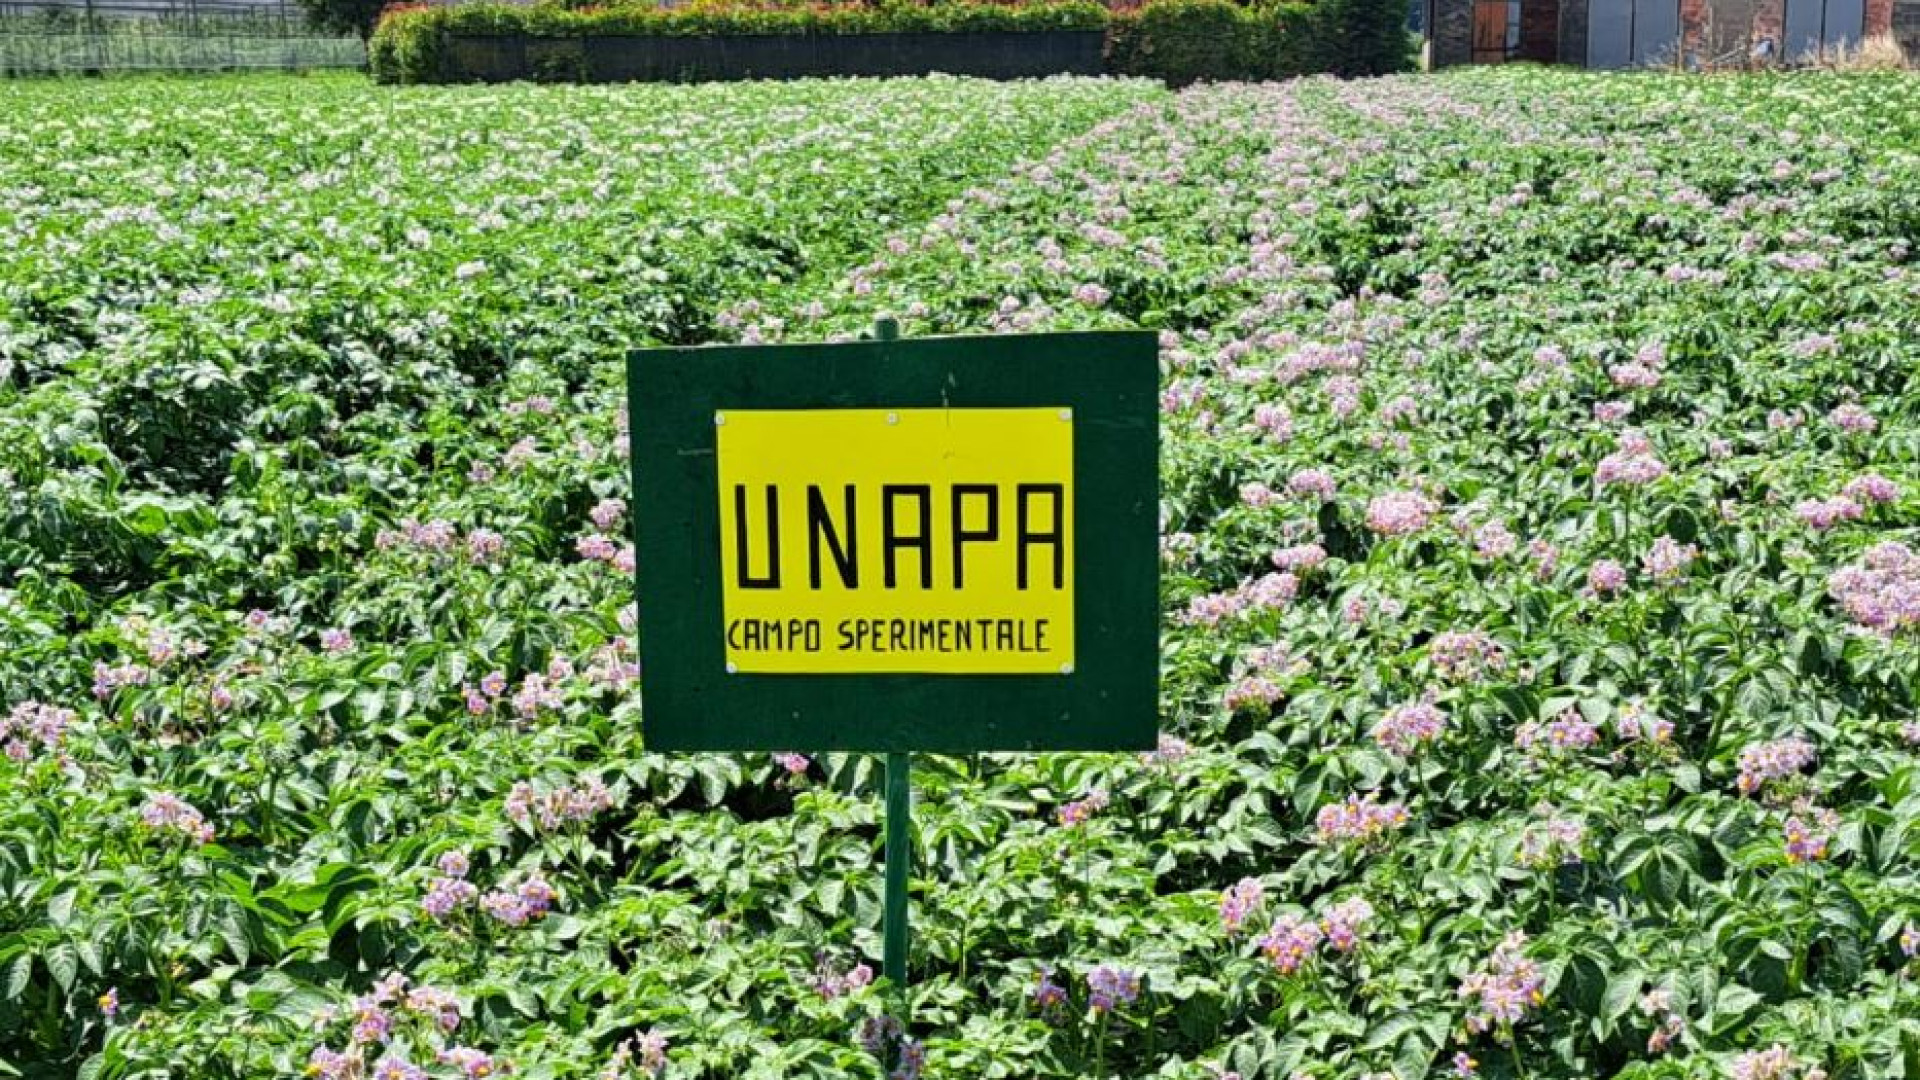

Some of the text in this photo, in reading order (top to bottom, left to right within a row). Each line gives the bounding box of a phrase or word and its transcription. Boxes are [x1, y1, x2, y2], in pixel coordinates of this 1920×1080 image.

[734, 483, 1065, 590] UNAPA
[727, 618, 1050, 652] CAMPO SPERIMENTALE
